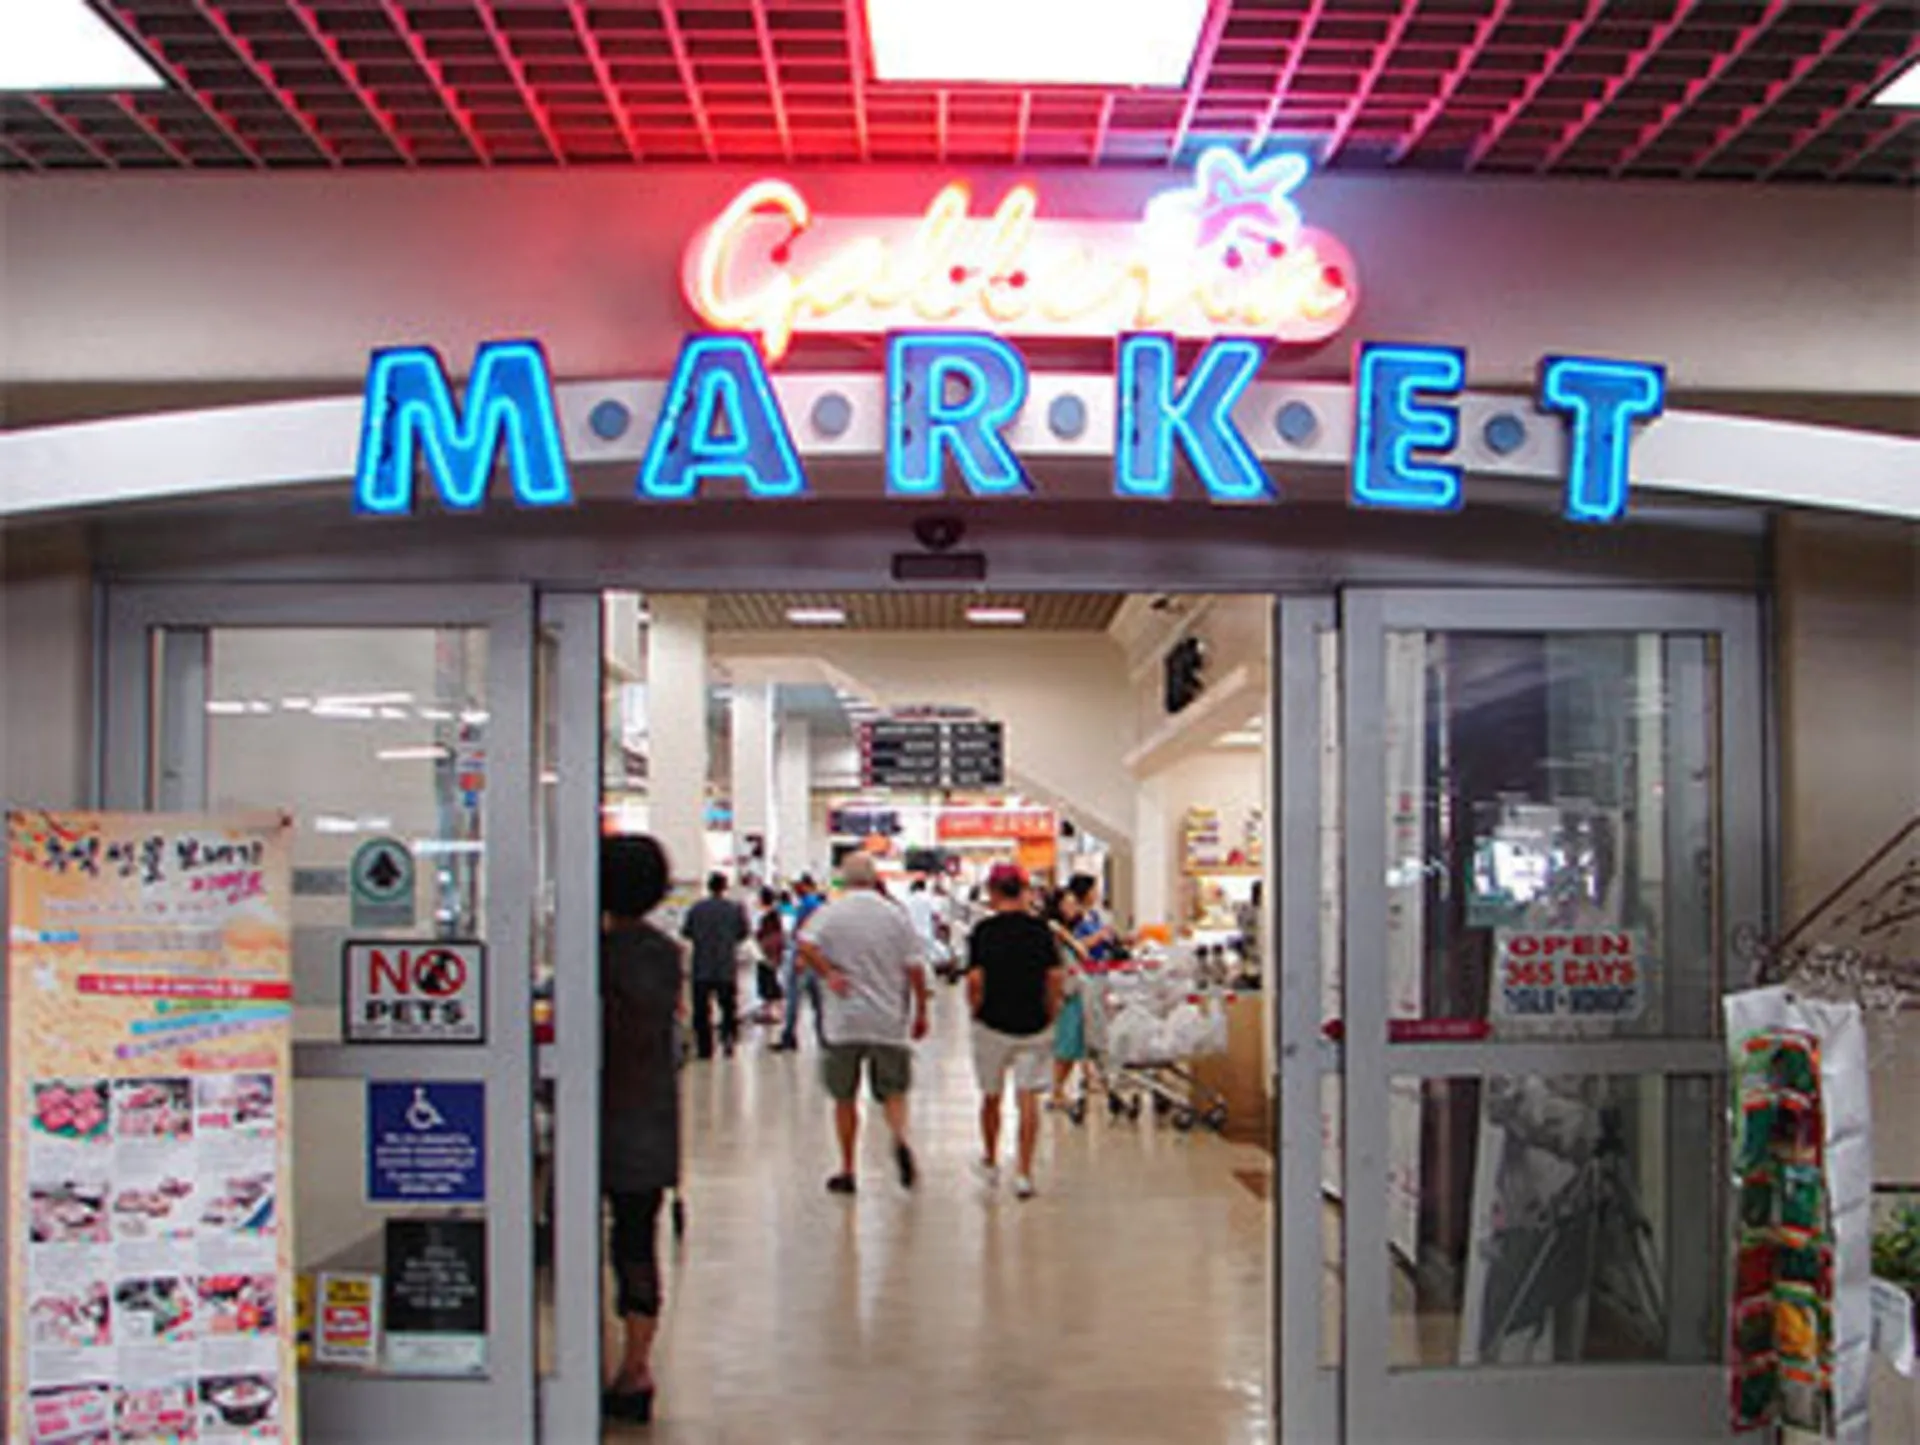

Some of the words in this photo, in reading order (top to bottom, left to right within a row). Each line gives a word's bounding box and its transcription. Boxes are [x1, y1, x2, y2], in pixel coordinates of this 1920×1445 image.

[355, 333, 1667, 523] MARKET
[1508, 934, 1631, 957] OPEN
[368, 948, 467, 997] NO
[1506, 960, 1554, 986] 365
[1562, 959, 1636, 986] DAYS
[365, 1000, 465, 1024] PETS
